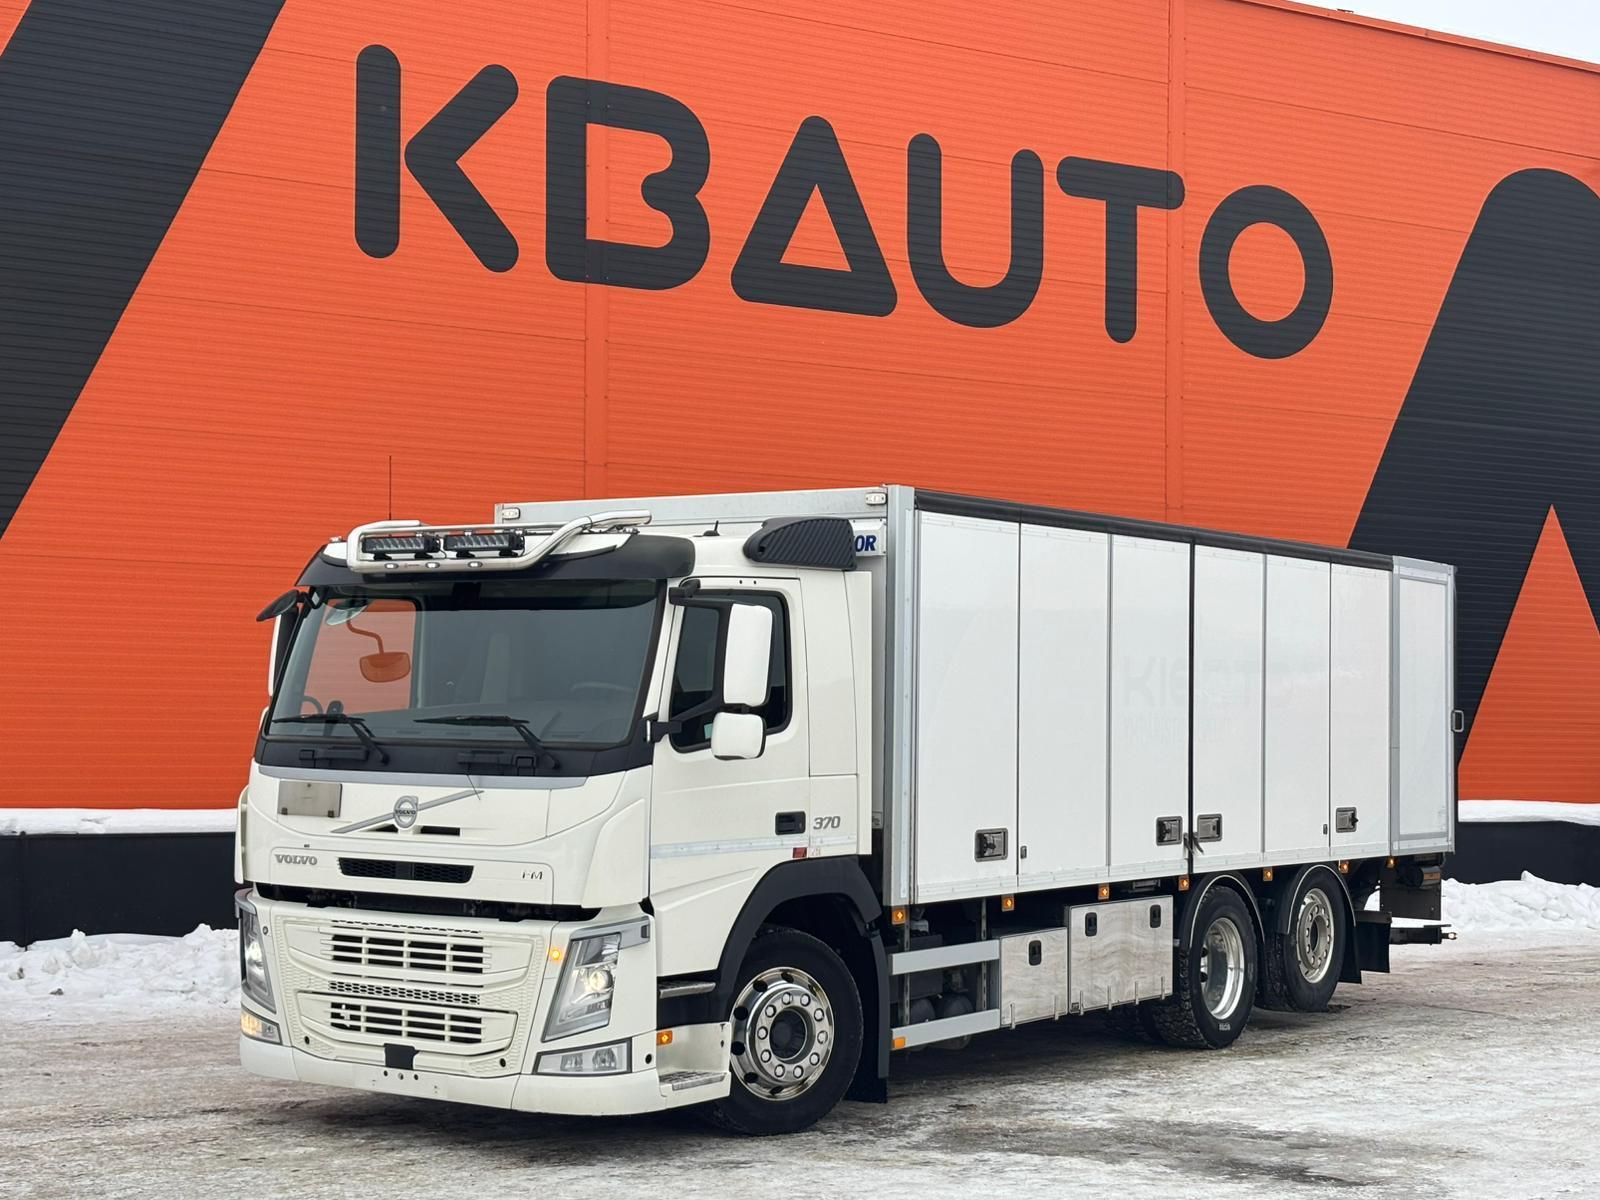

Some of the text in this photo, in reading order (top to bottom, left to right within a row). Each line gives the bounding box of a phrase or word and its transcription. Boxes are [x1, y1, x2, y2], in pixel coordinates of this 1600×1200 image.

[355, 45, 1333, 359] KBAUTO
[853, 534, 877, 552] OR
[813, 816, 841, 830] 370
[274, 854, 318, 866] VOLVO
